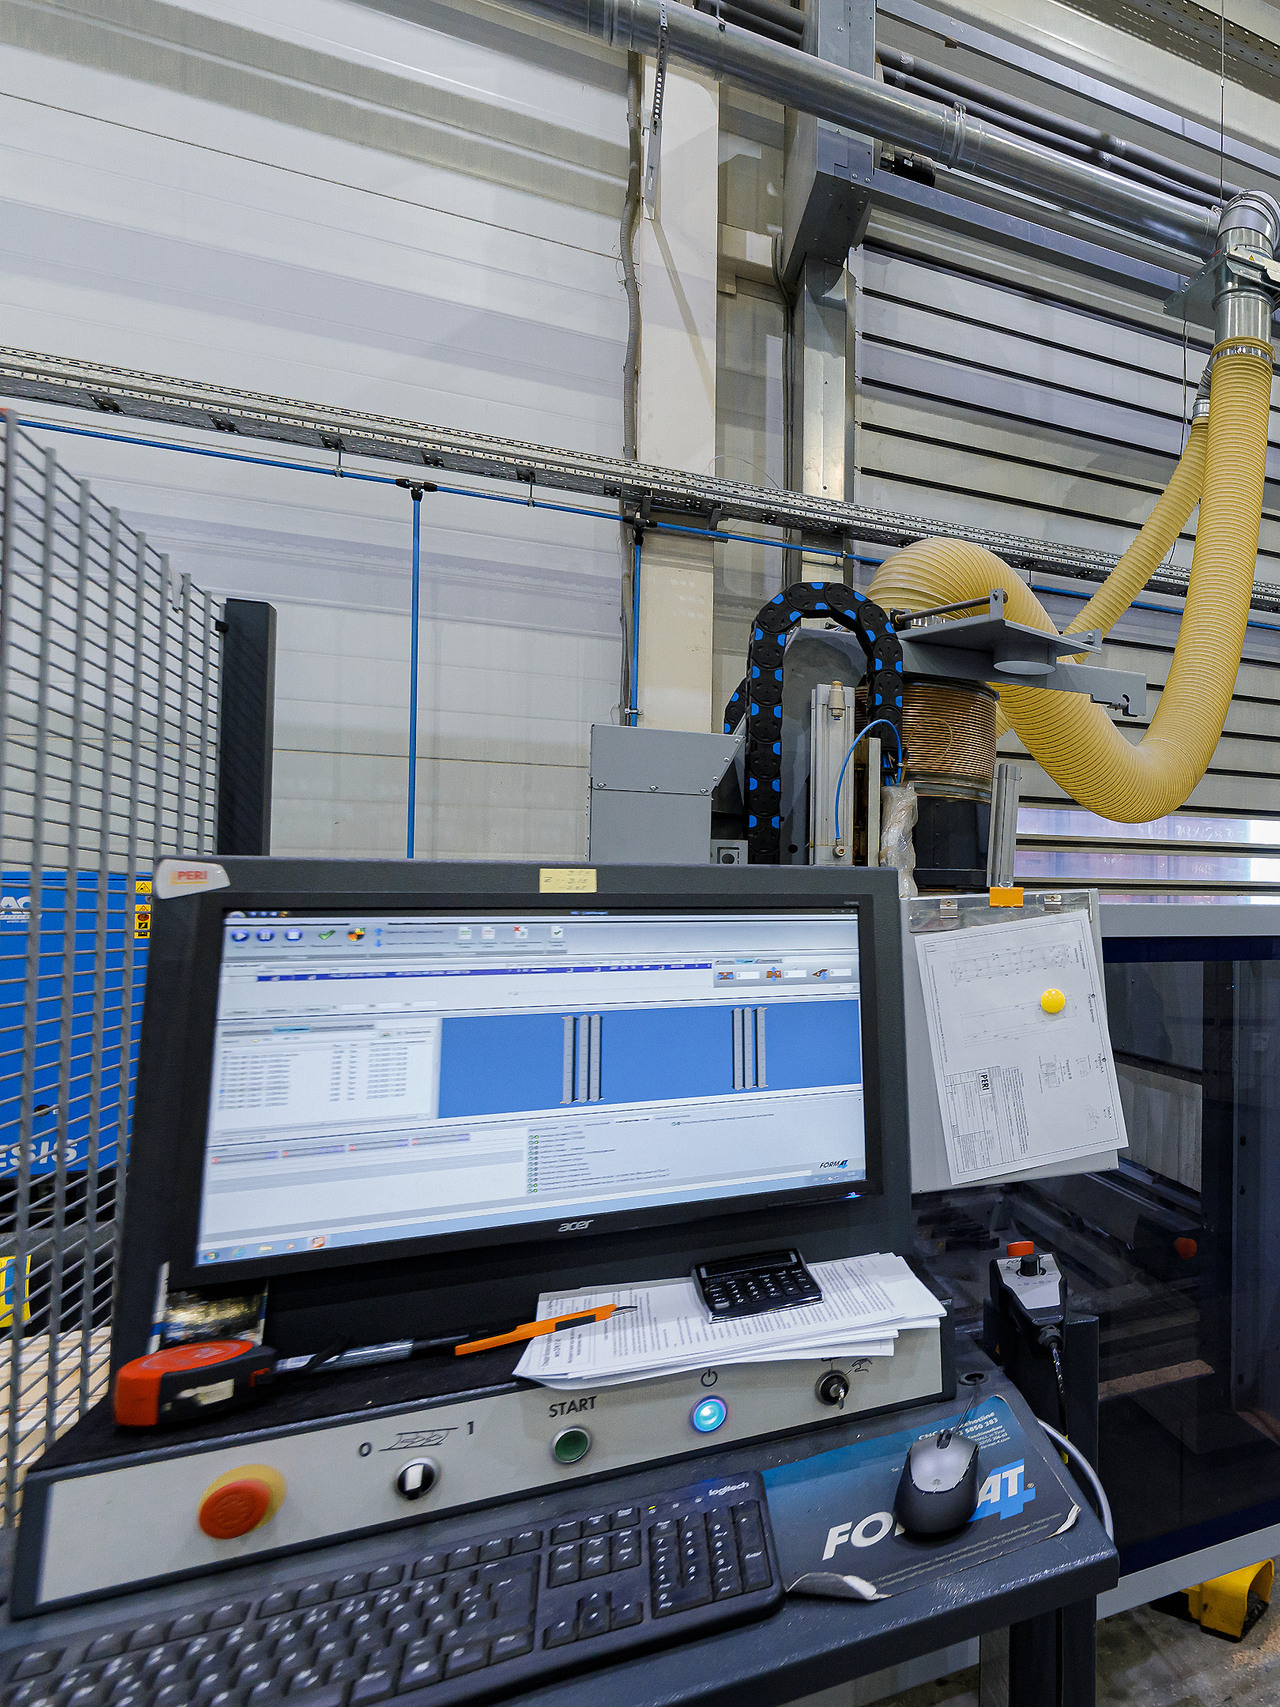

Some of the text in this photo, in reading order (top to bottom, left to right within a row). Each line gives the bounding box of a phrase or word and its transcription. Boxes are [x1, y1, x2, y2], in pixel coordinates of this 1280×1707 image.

[177, 870, 208, 880] PERI
[980, 1074, 990, 1091] PERI
[557, 1219, 595, 1233] acer
[549, 1395, 597, 1418] START
[708, 1480, 750, 1497] logitech
[822, 1464, 1025, 1562] FOAT
